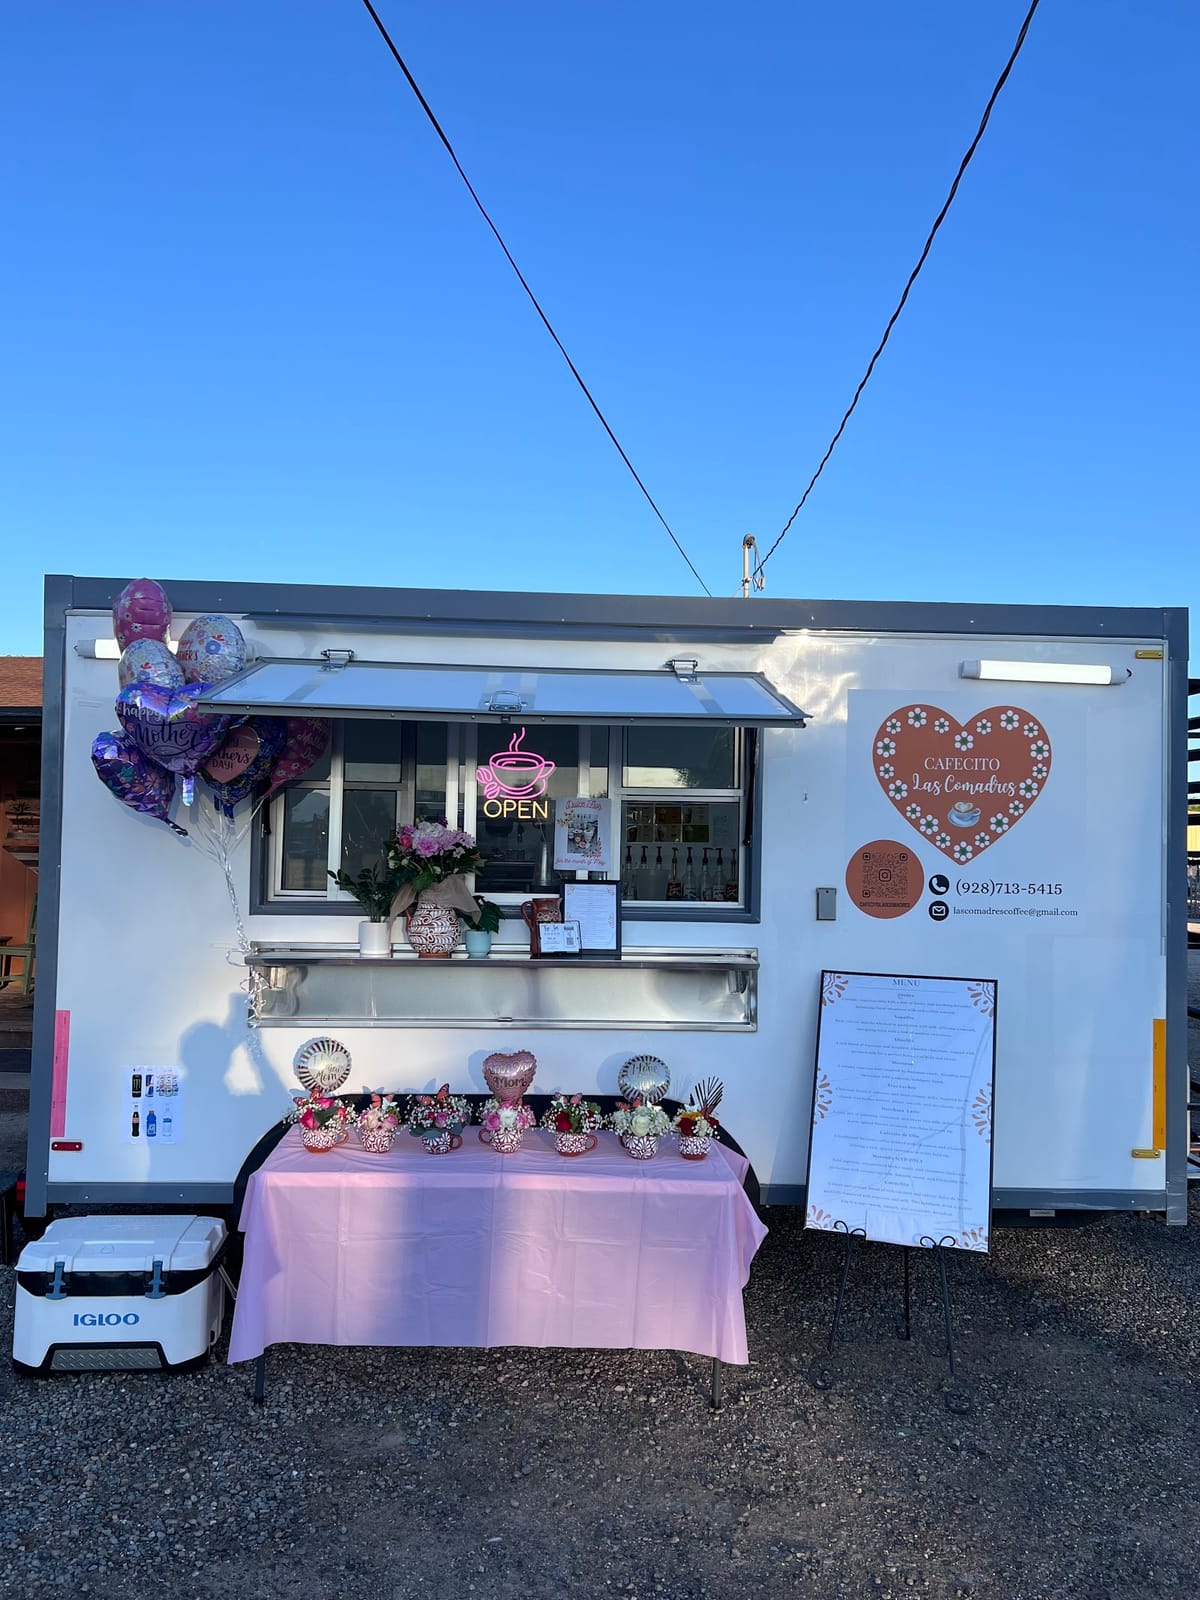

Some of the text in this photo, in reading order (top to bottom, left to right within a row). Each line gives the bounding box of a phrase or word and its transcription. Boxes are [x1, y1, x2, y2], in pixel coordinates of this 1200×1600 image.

[923, 757, 1001, 771] CAFECITO
[912, 773, 1018, 797] Las Comadres
[483, 799, 549, 819] OPEN
[956, 879, 1063, 896] (928)713-5415
[953, 907, 1078, 917] lascomadrescoffee@gmail.com
[893, 979, 920, 987] MENU
[73, 1313, 140, 1327] IGLOO
